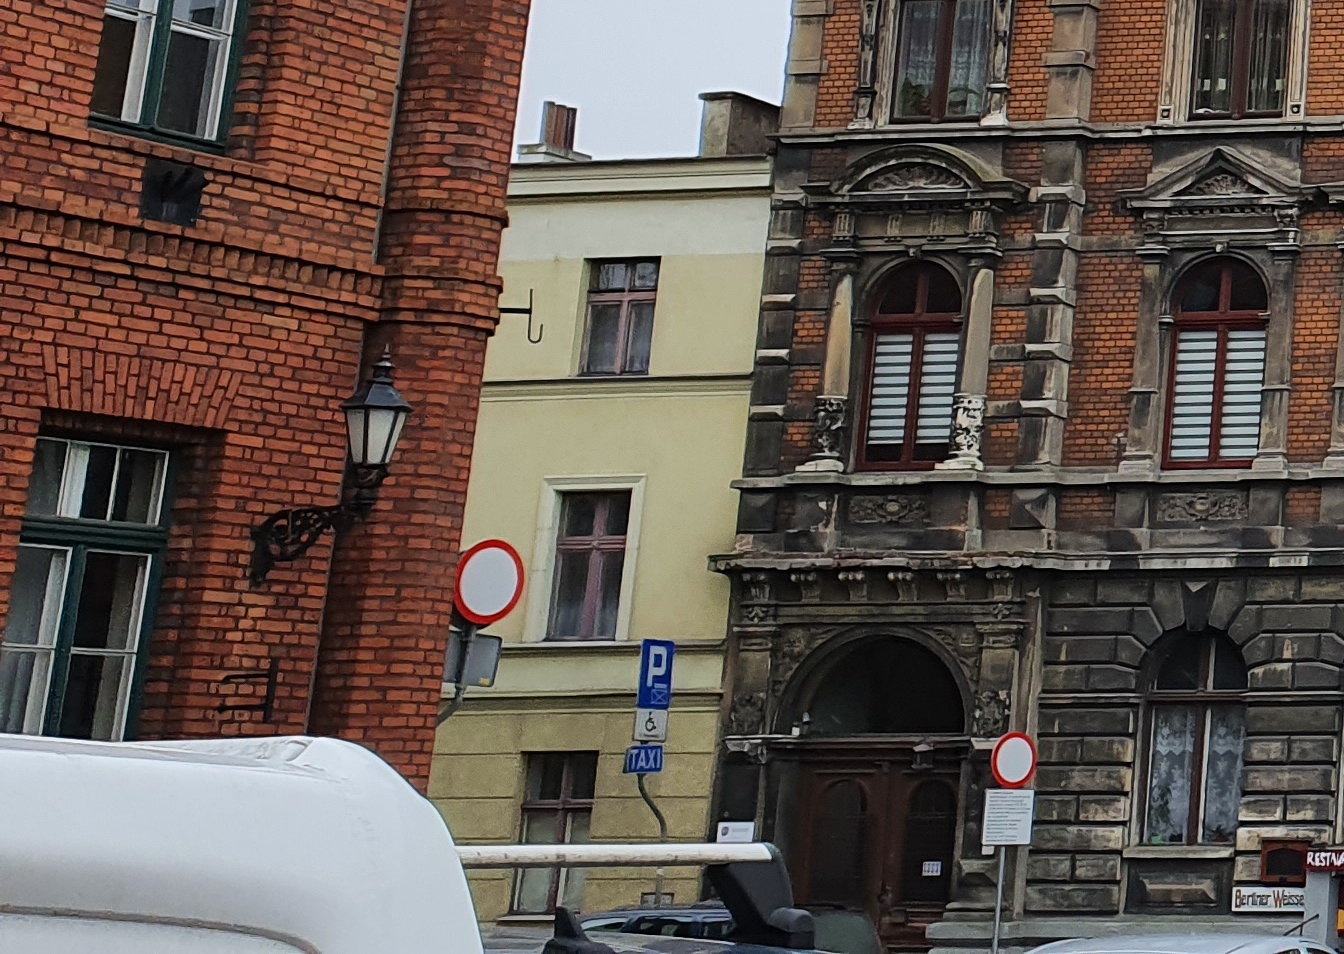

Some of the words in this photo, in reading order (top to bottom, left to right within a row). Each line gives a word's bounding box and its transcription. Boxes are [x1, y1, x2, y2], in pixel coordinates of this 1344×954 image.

[646, 645, 668, 688] P
[629, 748, 662, 770] TAXI
[1235, 889, 1271, 909] Berliner
[1272, 889, 1305, 909] Weisse
